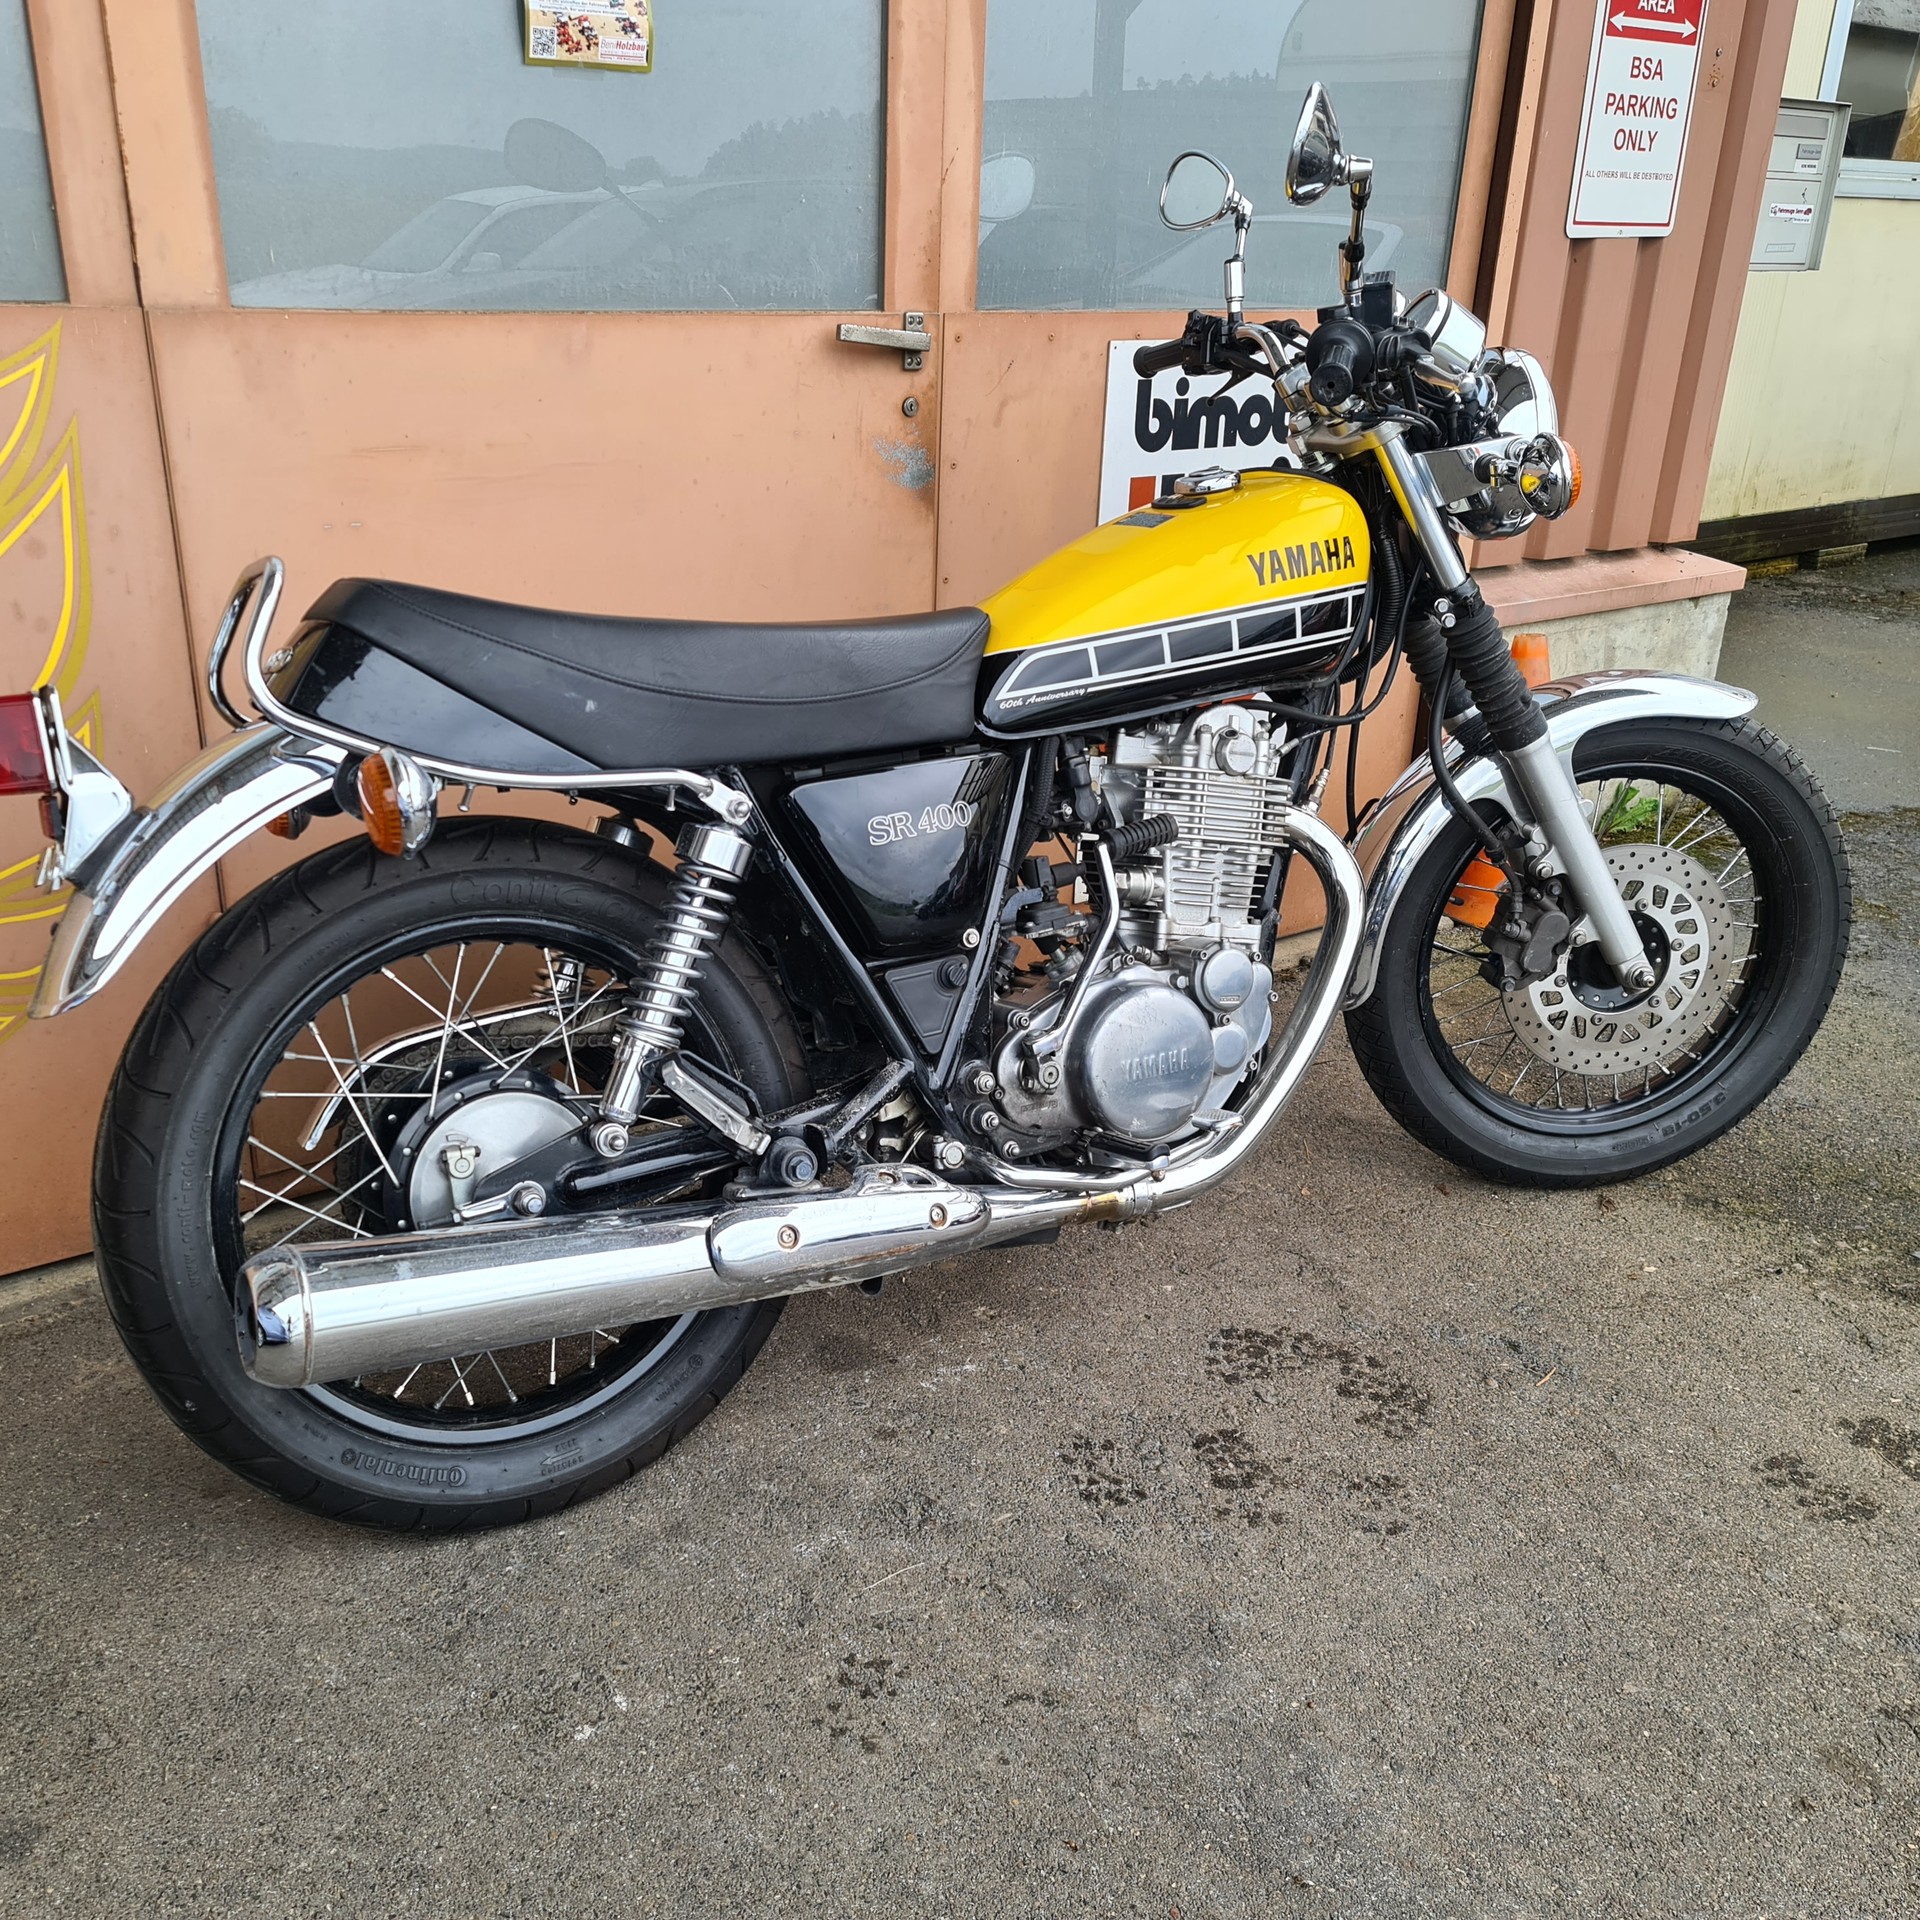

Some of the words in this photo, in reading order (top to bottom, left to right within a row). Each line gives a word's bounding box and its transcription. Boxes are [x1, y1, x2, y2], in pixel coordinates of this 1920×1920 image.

[1637, 0, 1675, 14] AREA
[1630, 56, 1663, 81] BSA
[1604, 92, 1678, 120] PARKING
[1613, 128, 1658, 152] ONLY
[1584, 170, 1595, 178] ALL
[1597, 170, 1618, 179] OTHERS
[1620, 171, 1632, 180] WILL
[1633, 172, 1641, 180] BE
[1641, 172, 1673, 181] DESTROYED
[1246, 536, 1355, 586] YAMAHA
[999, 697, 1024, 710] 60th
[1025, 688, 1085, 705] Anniversary
[1121, 1048, 1189, 1081] YAMAHA
[355, 1453, 467, 1488] Continental
